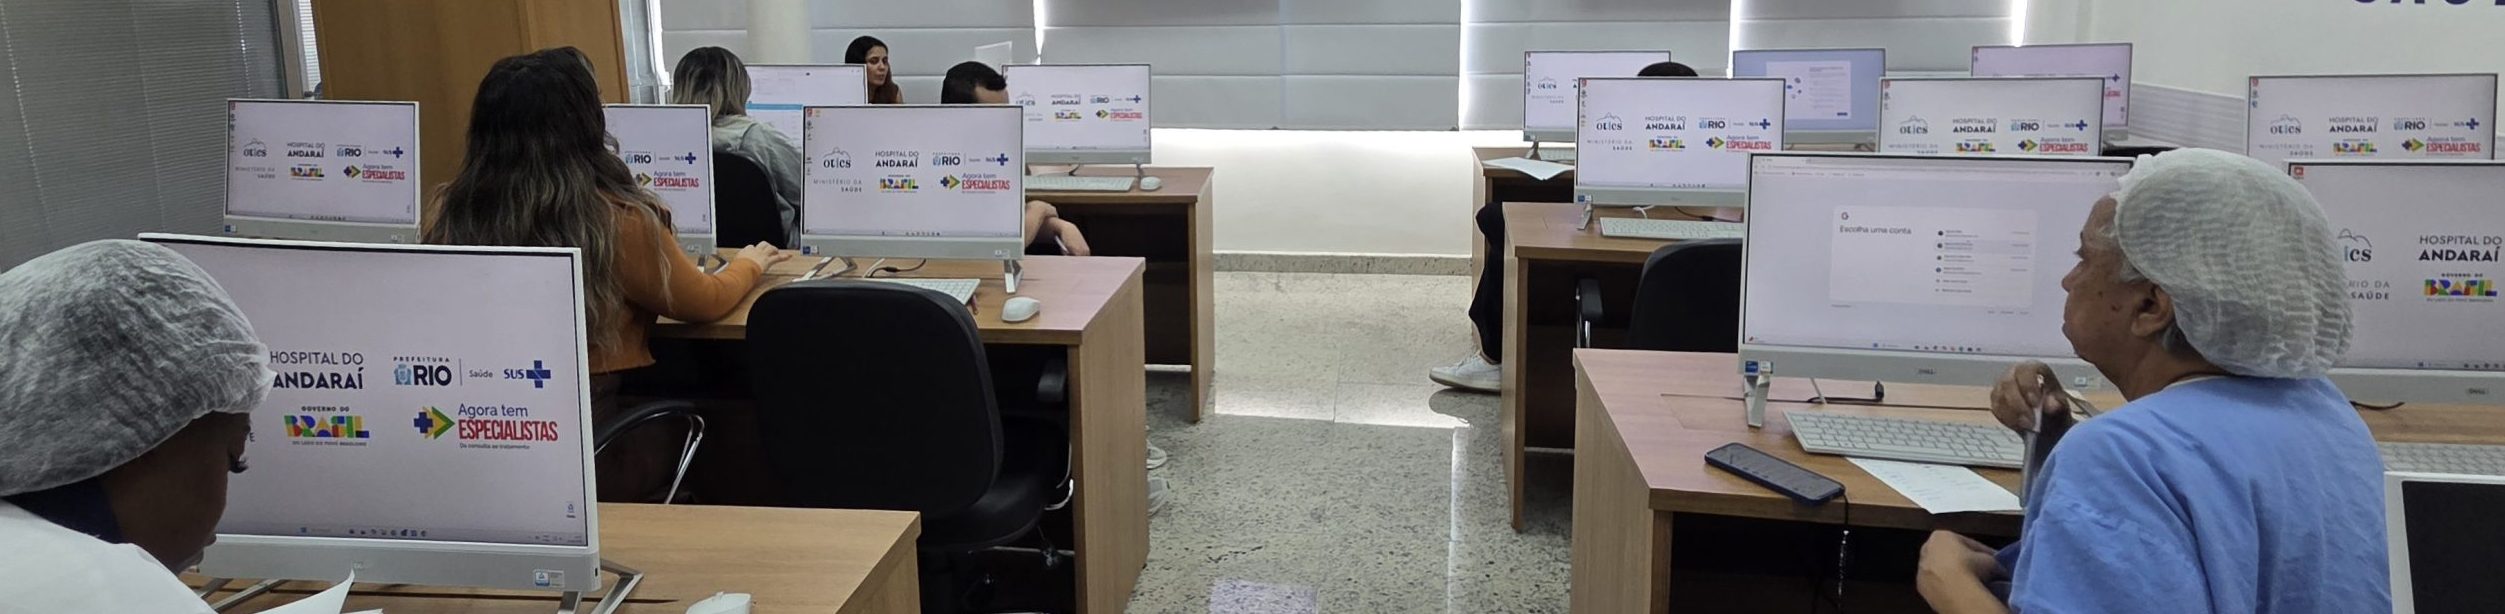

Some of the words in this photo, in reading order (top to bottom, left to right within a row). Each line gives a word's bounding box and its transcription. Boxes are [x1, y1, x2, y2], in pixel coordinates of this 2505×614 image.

[1646, 120, 1685, 130] ANDARAÍ
[1708, 120, 1726, 129] RIO
[1900, 124, 1928, 134] otics
[1953, 122, 1996, 133] ANDARAÍ
[2021, 122, 2039, 131] RIO
[2270, 124, 2301, 134] otics
[2329, 122, 2377, 132] ANDARAÍ
[2404, 121, 2425, 130] RIO
[2426, 142, 2480, 152] ESPECIALISTAS
[287, 148, 324, 158] ANDARAÍ
[345, 148, 362, 157] RIO
[634, 154, 651, 164] RIO
[823, 156, 851, 168] otics
[876, 157, 918, 168] ANDARAÍ
[942, 156, 960, 166] RIO
[362, 170, 405, 180] ESPECIALISTAS
[654, 178, 700, 188] ESPECIALISTAS
[962, 180, 1010, 190] ESPECIALISTAS
[1840, 226, 1869, 234] Escolha
[2419, 235, 2479, 245] HOSPITAL
[2483, 236, 2502, 246] DO
[2344, 246, 2371, 262] ics
[2419, 246, 2500, 262] ANDARAÍ
[2424, 280, 2497, 296] BRASIL
[2351, 290, 2389, 300] SAÚDE
[270, 351, 338, 364] HOSPITAL
[342, 352, 364, 365] DO
[273, 367, 364, 389] ANDARAÍ
[413, 365, 452, 386] RIO
[469, 369, 493, 378] Saúde
[504, 369, 524, 379] SUS
[458, 403, 498, 419] Agora
[502, 404, 528, 417] tem
[284, 415, 369, 438] BRASIL
[458, 419, 558, 441] ESPECIALISTAS
